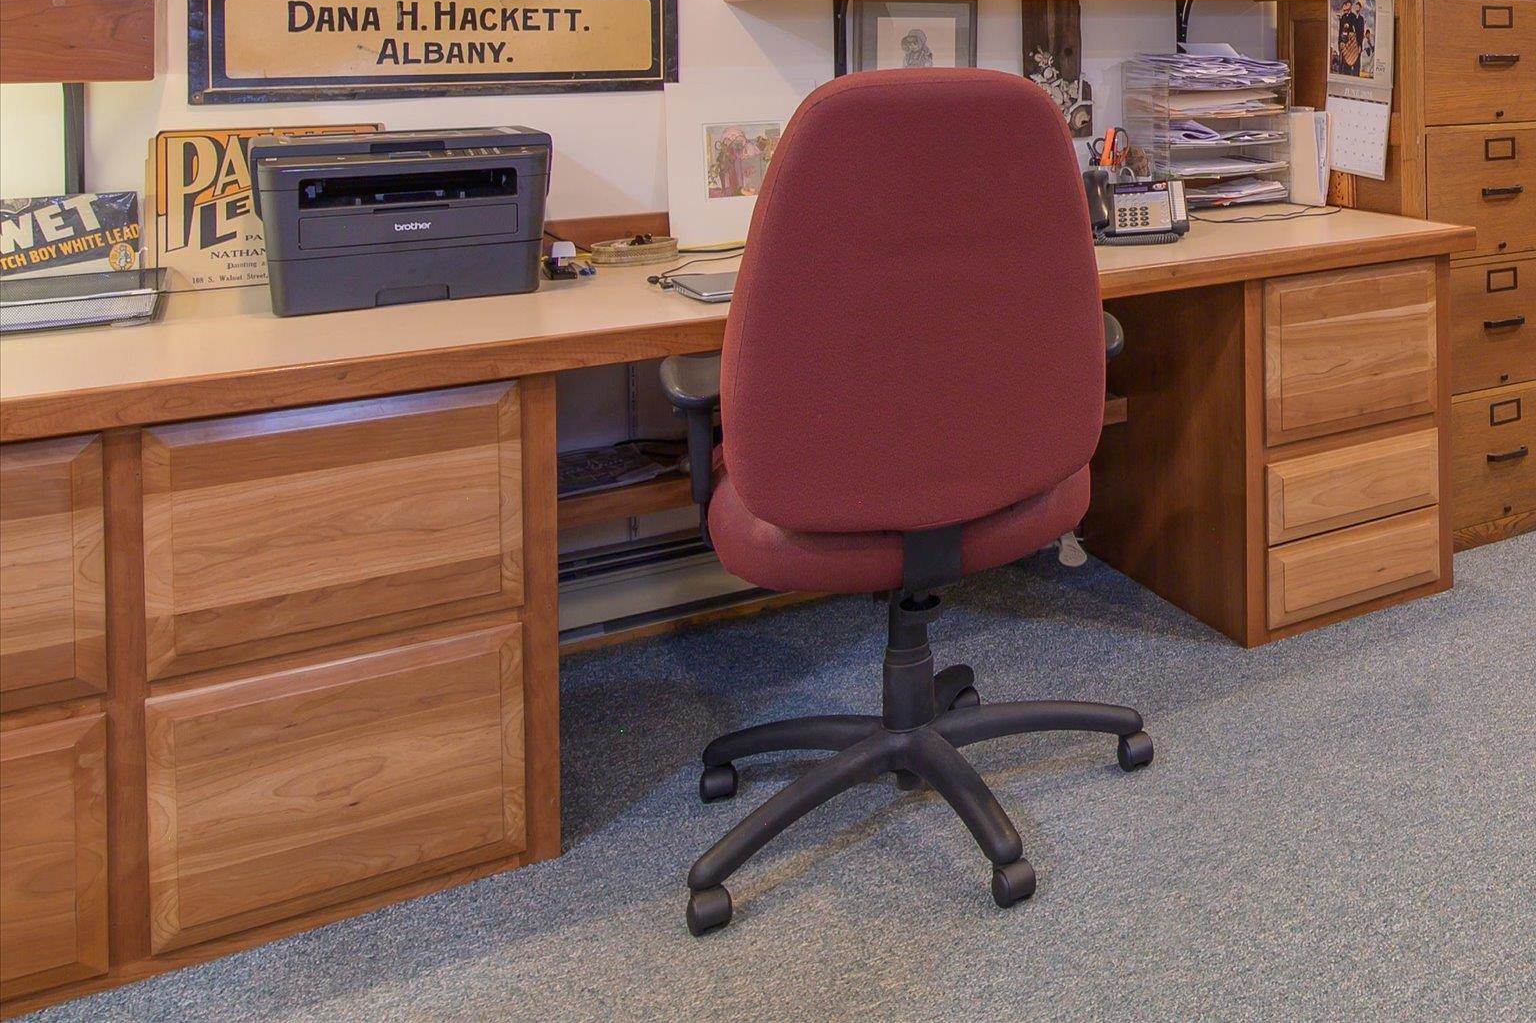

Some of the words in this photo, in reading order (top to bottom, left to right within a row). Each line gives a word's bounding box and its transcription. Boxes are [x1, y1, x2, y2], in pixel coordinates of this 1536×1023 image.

[287, 0, 381, 33] DANA
[376, 38, 514, 65] ALBANY.
[395, 221, 431, 232] brother
[29, 244, 58, 264] BOY
[58, 232, 106, 257] WHITE
[105, 223, 140, 245] LEAD
